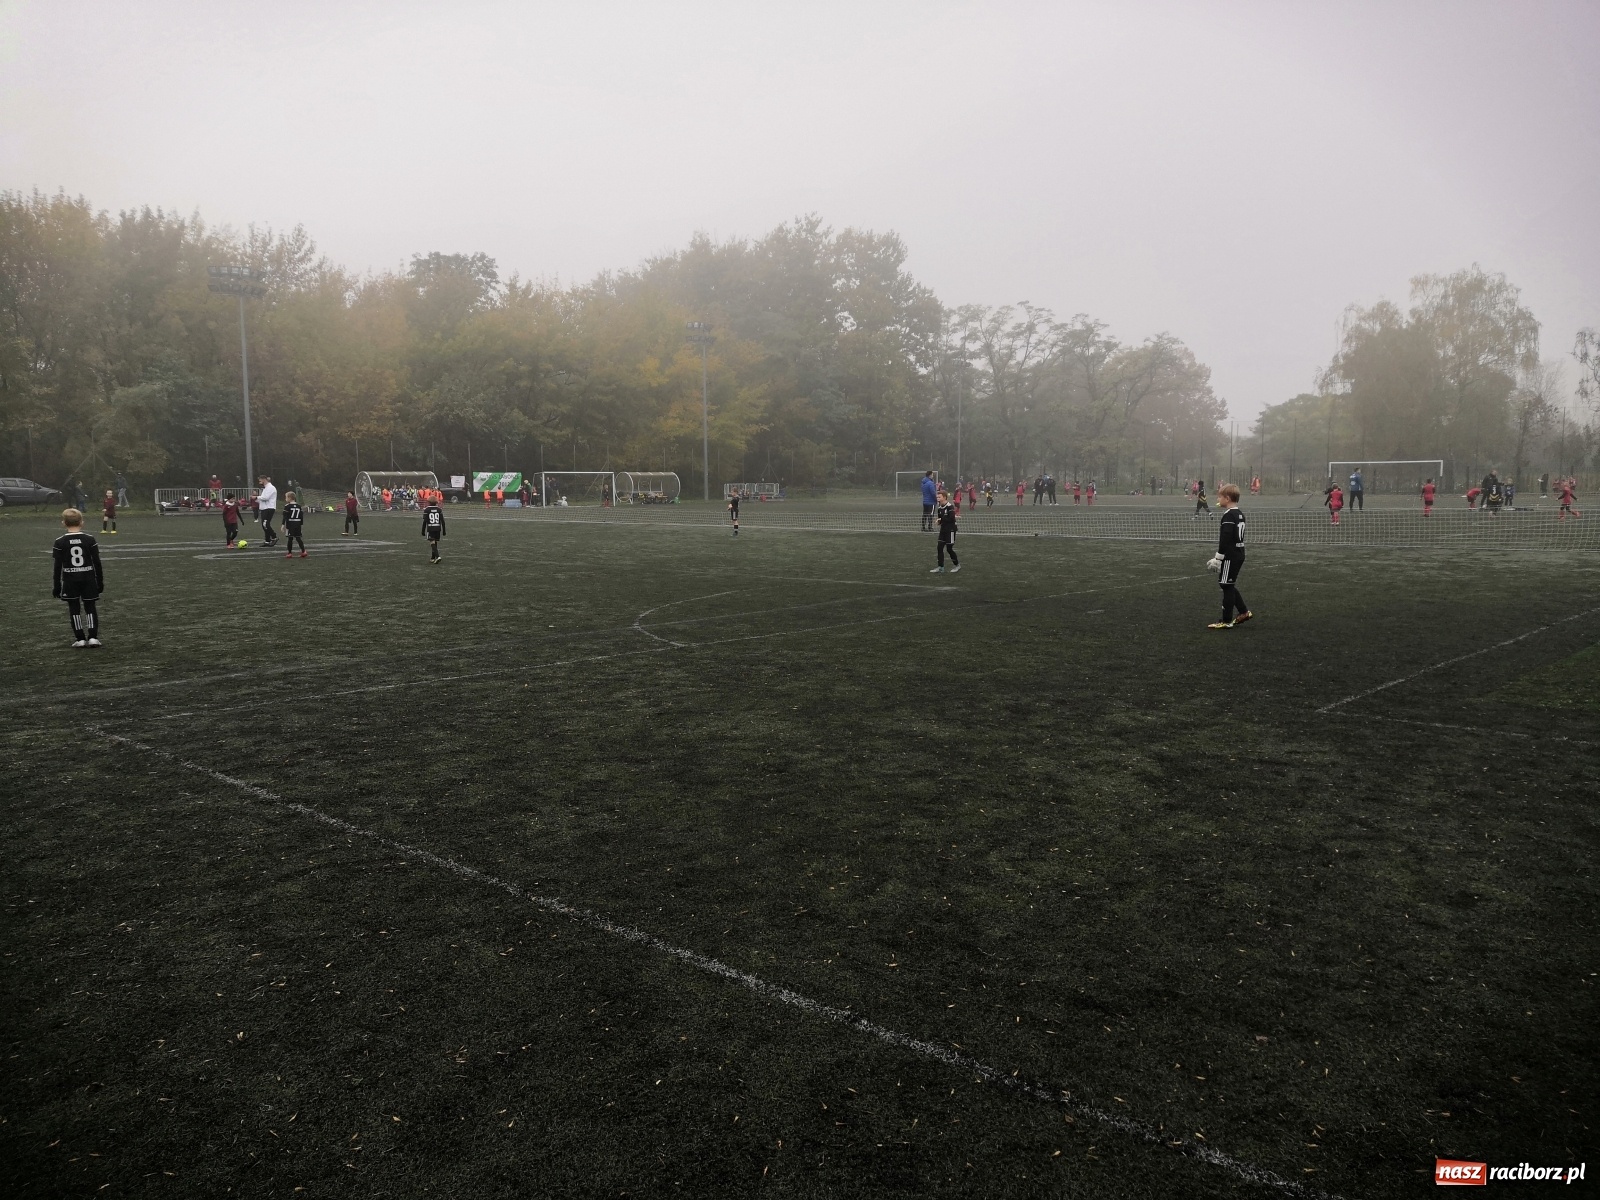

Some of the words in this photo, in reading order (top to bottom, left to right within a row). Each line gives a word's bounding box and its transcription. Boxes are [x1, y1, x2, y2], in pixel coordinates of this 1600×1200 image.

[290, 507, 301, 519] 77
[428, 512, 440, 524] 99
[70, 546, 84, 567] 8
